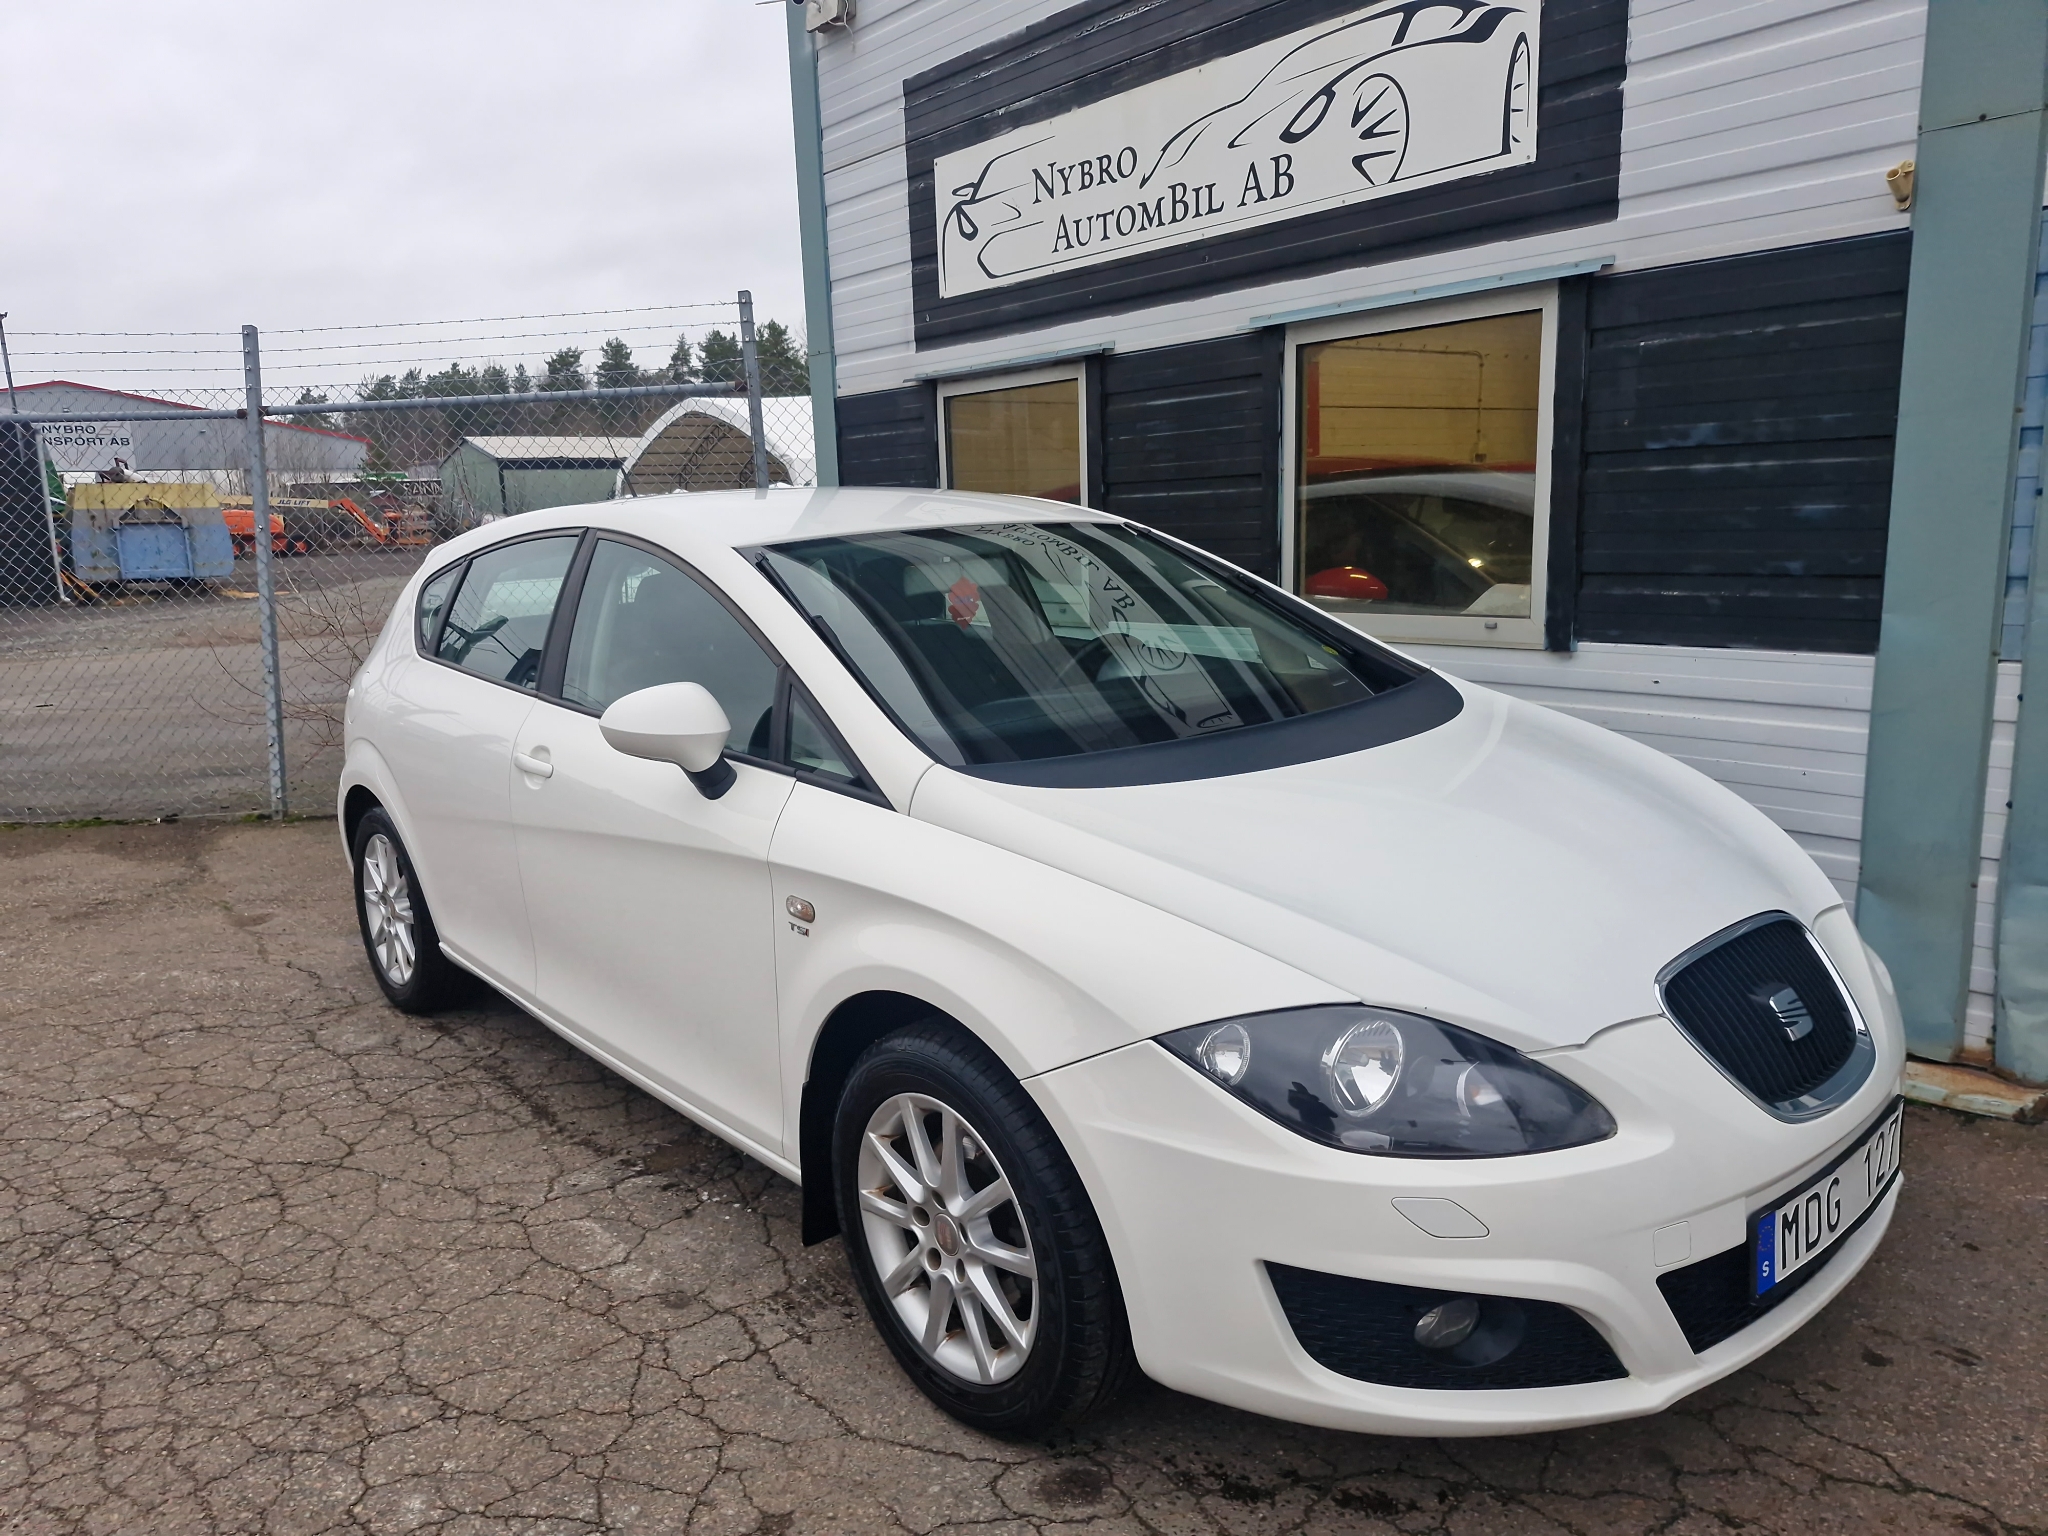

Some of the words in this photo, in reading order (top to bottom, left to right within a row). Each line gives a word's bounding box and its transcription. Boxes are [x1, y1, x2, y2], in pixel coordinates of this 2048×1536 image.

[1031, 146, 1138, 204] NYBRO
[1236, 153, 1296, 207] AB
[41, 425, 96, 434] NYBRO
[109, 437, 130, 446] AB
[1762, 1260, 1769, 1277] S
[1780, 1176, 1841, 1270] MDG
[1863, 1113, 1899, 1197] 127
